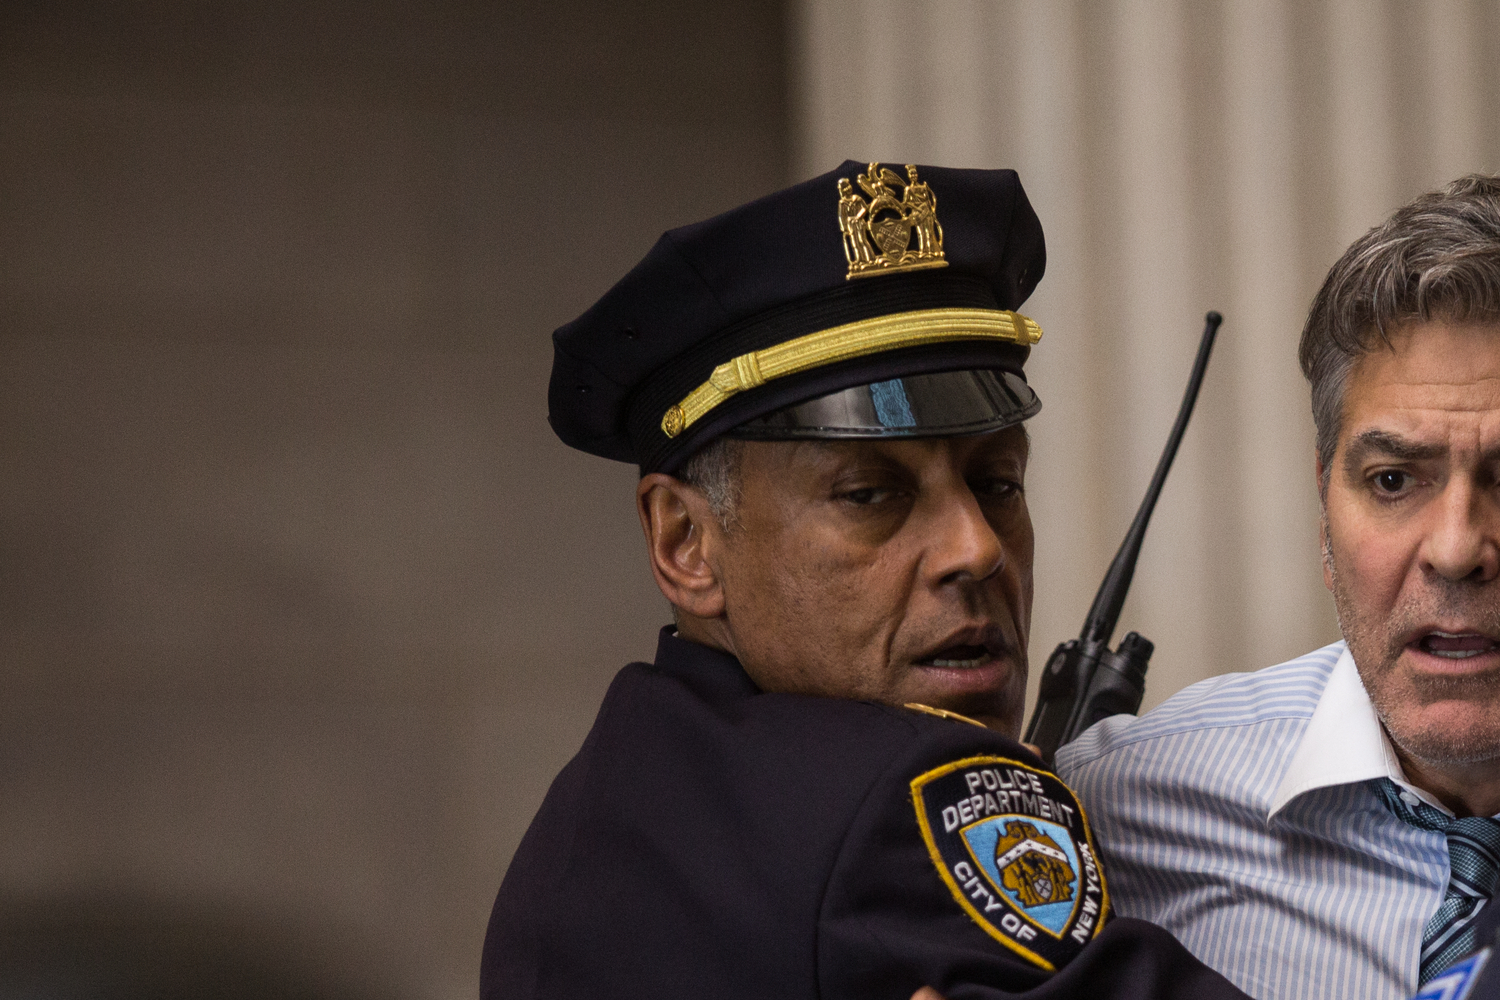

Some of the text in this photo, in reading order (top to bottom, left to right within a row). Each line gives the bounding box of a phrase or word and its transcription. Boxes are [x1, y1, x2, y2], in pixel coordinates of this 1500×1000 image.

[965, 769, 1043, 794] POLICE
[941, 791, 1074, 833] DEPARTMENT
[954, 841, 1101, 944] CITY OF NEW YORK
